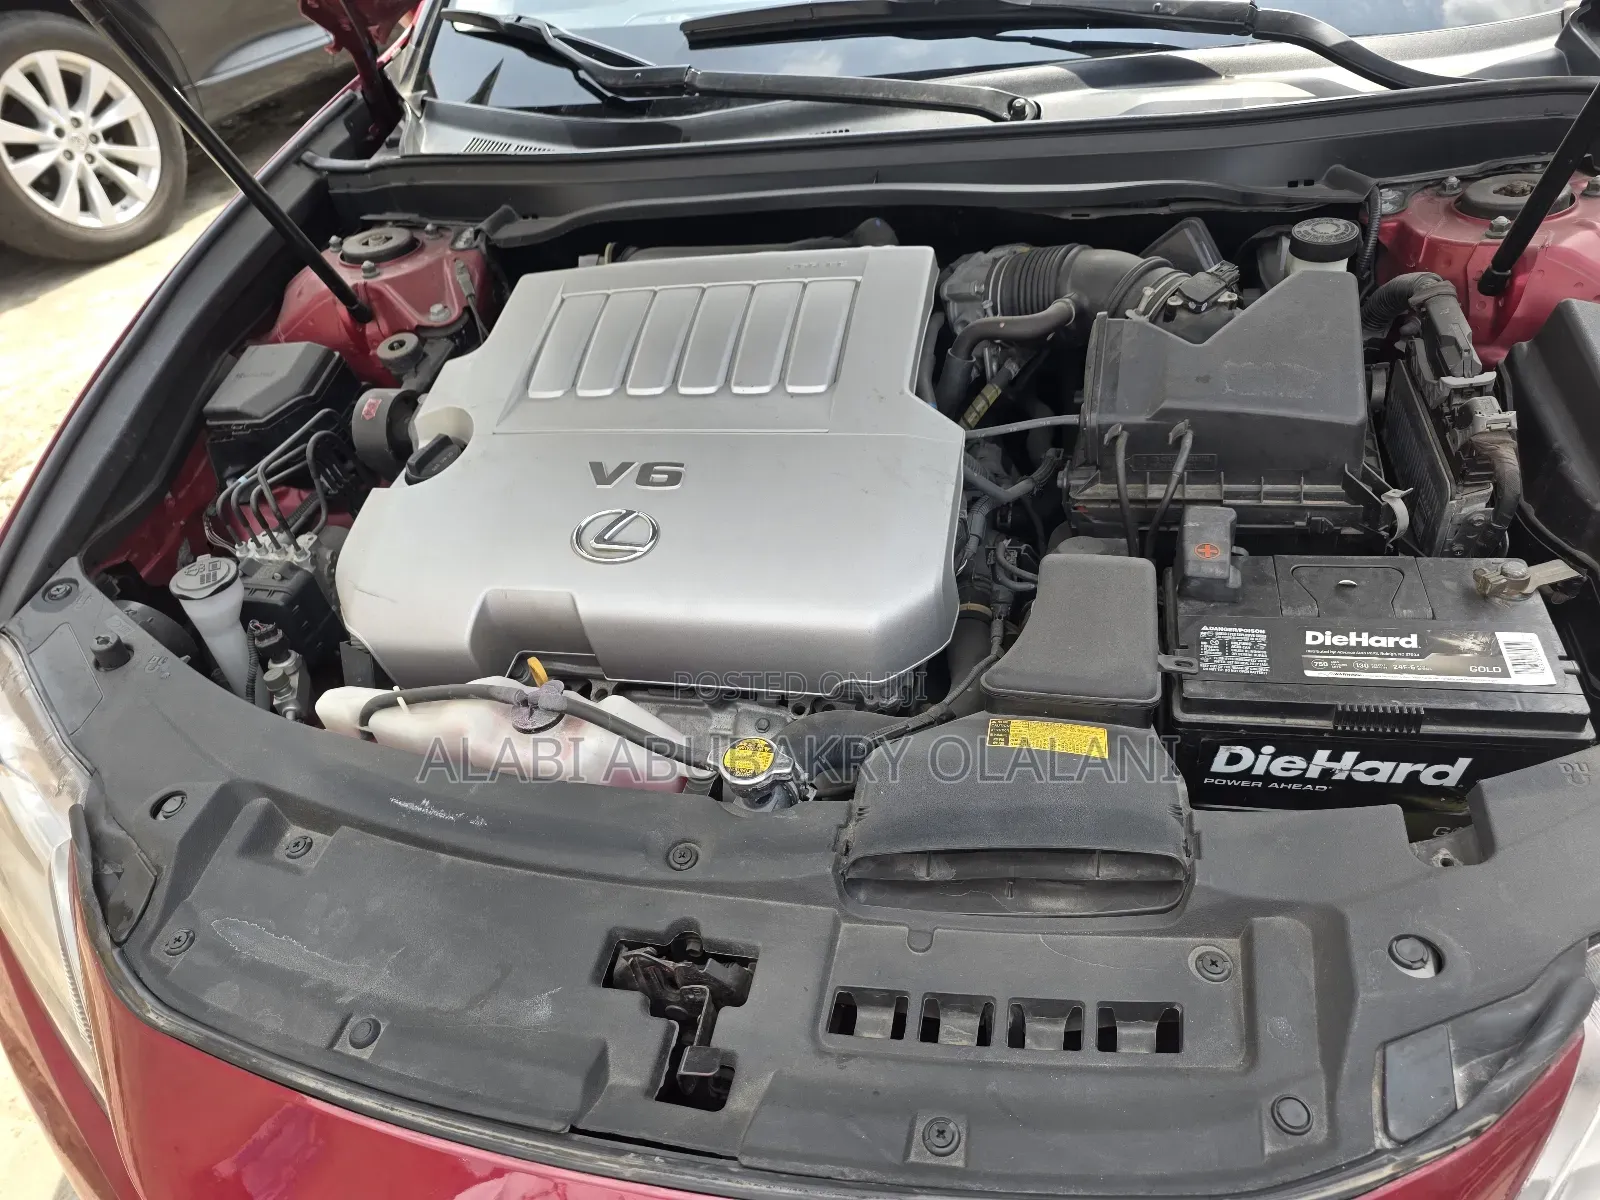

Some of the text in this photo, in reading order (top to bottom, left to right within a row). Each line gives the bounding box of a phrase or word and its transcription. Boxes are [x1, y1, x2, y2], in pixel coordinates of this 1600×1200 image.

[588, 461, 686, 490] V6
[1305, 630, 1418, 649] DieHard
[1469, 665, 1502, 673] GOLD
[1210, 745, 1473, 788] DieHard
[1203, 777, 1328, 792] POWER AHEAD
